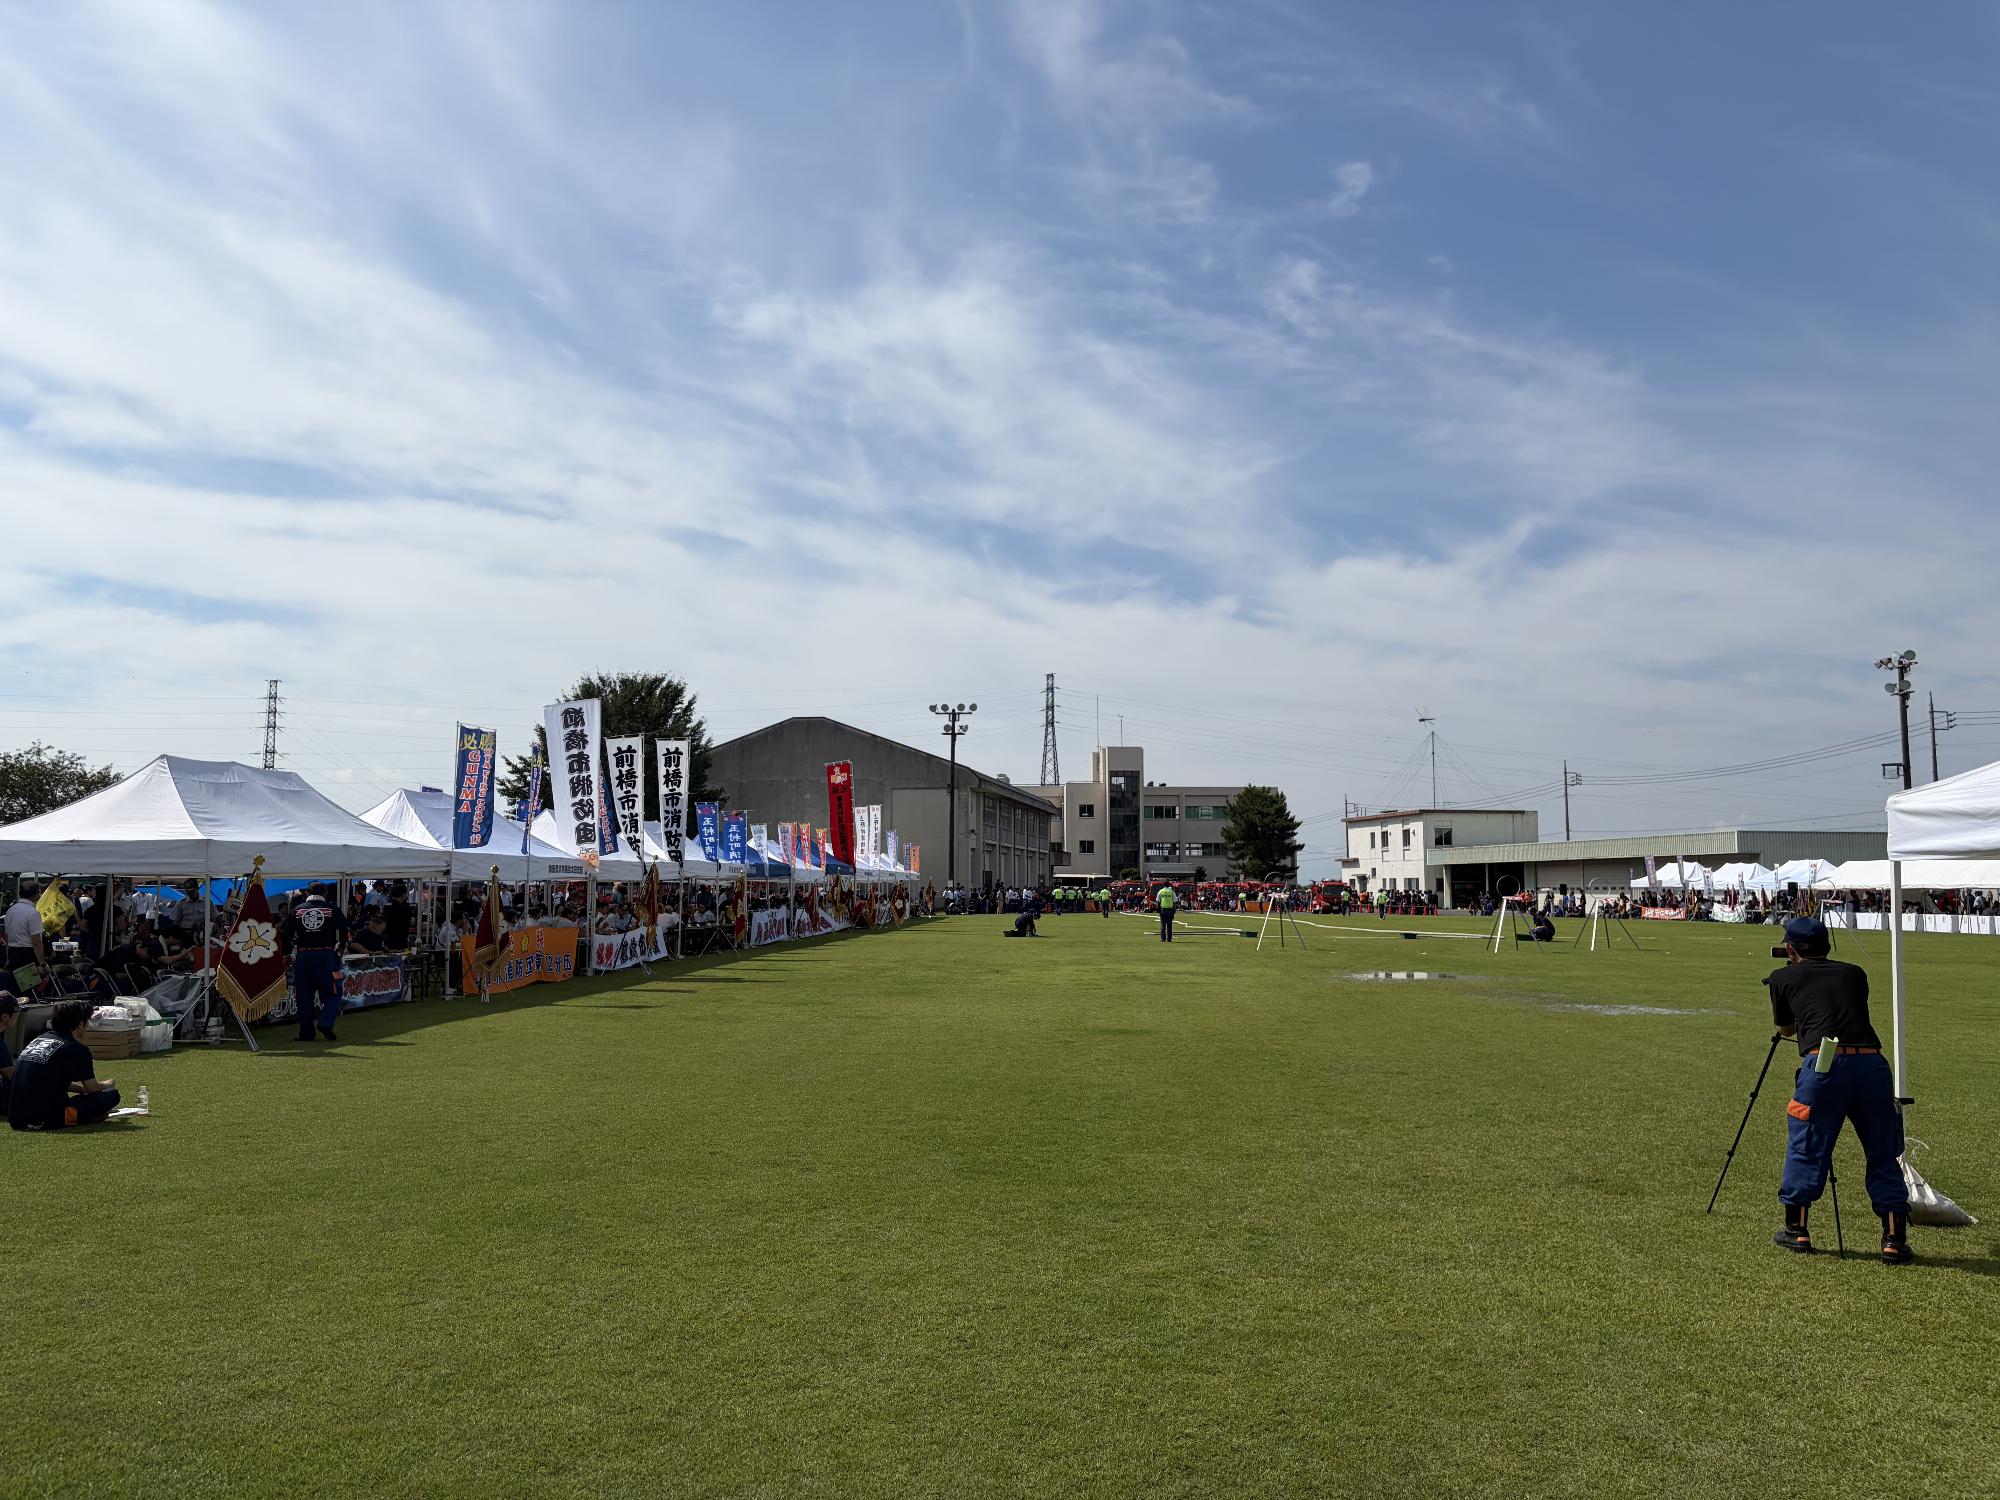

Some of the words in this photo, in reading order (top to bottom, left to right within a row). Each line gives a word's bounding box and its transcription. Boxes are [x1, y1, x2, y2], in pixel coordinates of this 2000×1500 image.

[459, 731, 496, 751] 必勝
[482, 747, 495, 769] OTA
[458, 750, 481, 813] GUNMA
[478, 769, 490, 798] FIRE
[471, 799, 486, 833] CORPS
